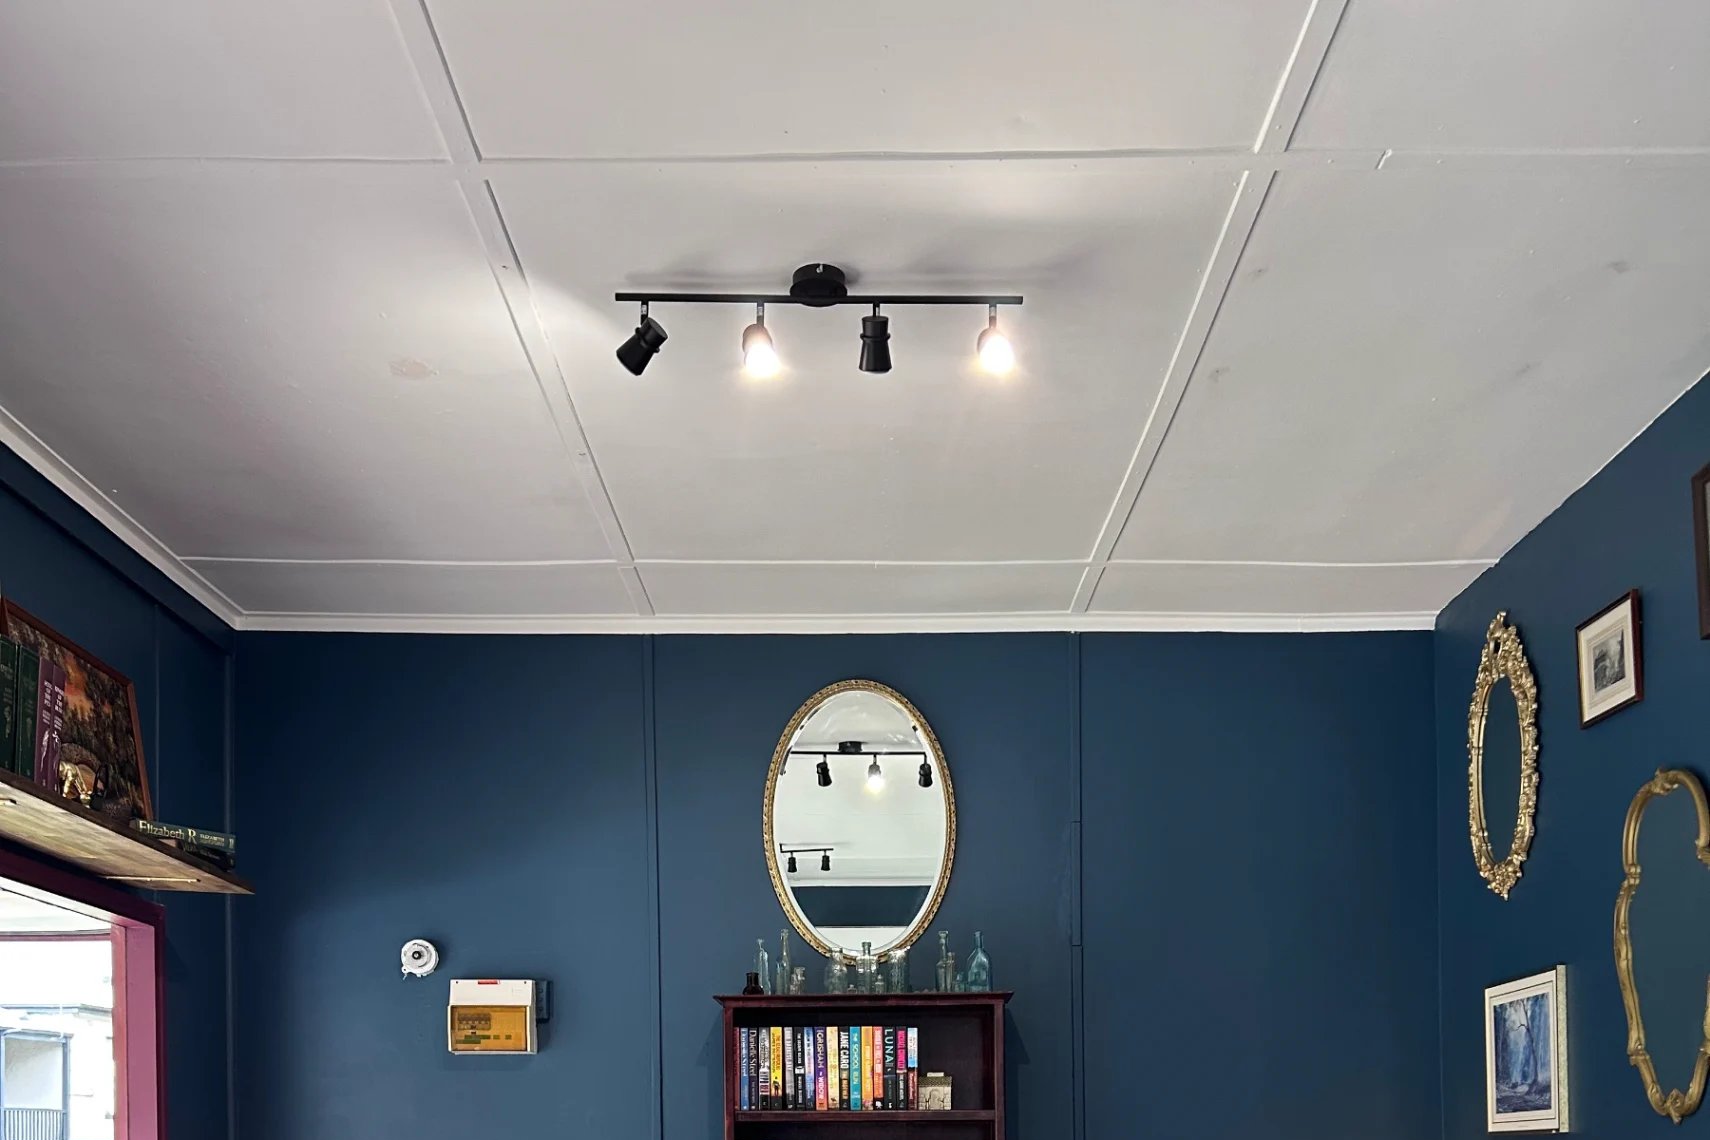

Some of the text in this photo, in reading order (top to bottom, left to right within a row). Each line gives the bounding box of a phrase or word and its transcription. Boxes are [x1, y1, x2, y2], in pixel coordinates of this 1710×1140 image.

[138, 820, 198, 844] Elizabeth R
[749, 1030, 757, 1057] Danielle
[840, 1032, 849, 1068] JANE CARO
[884, 1029, 893, 1062] LUNA
